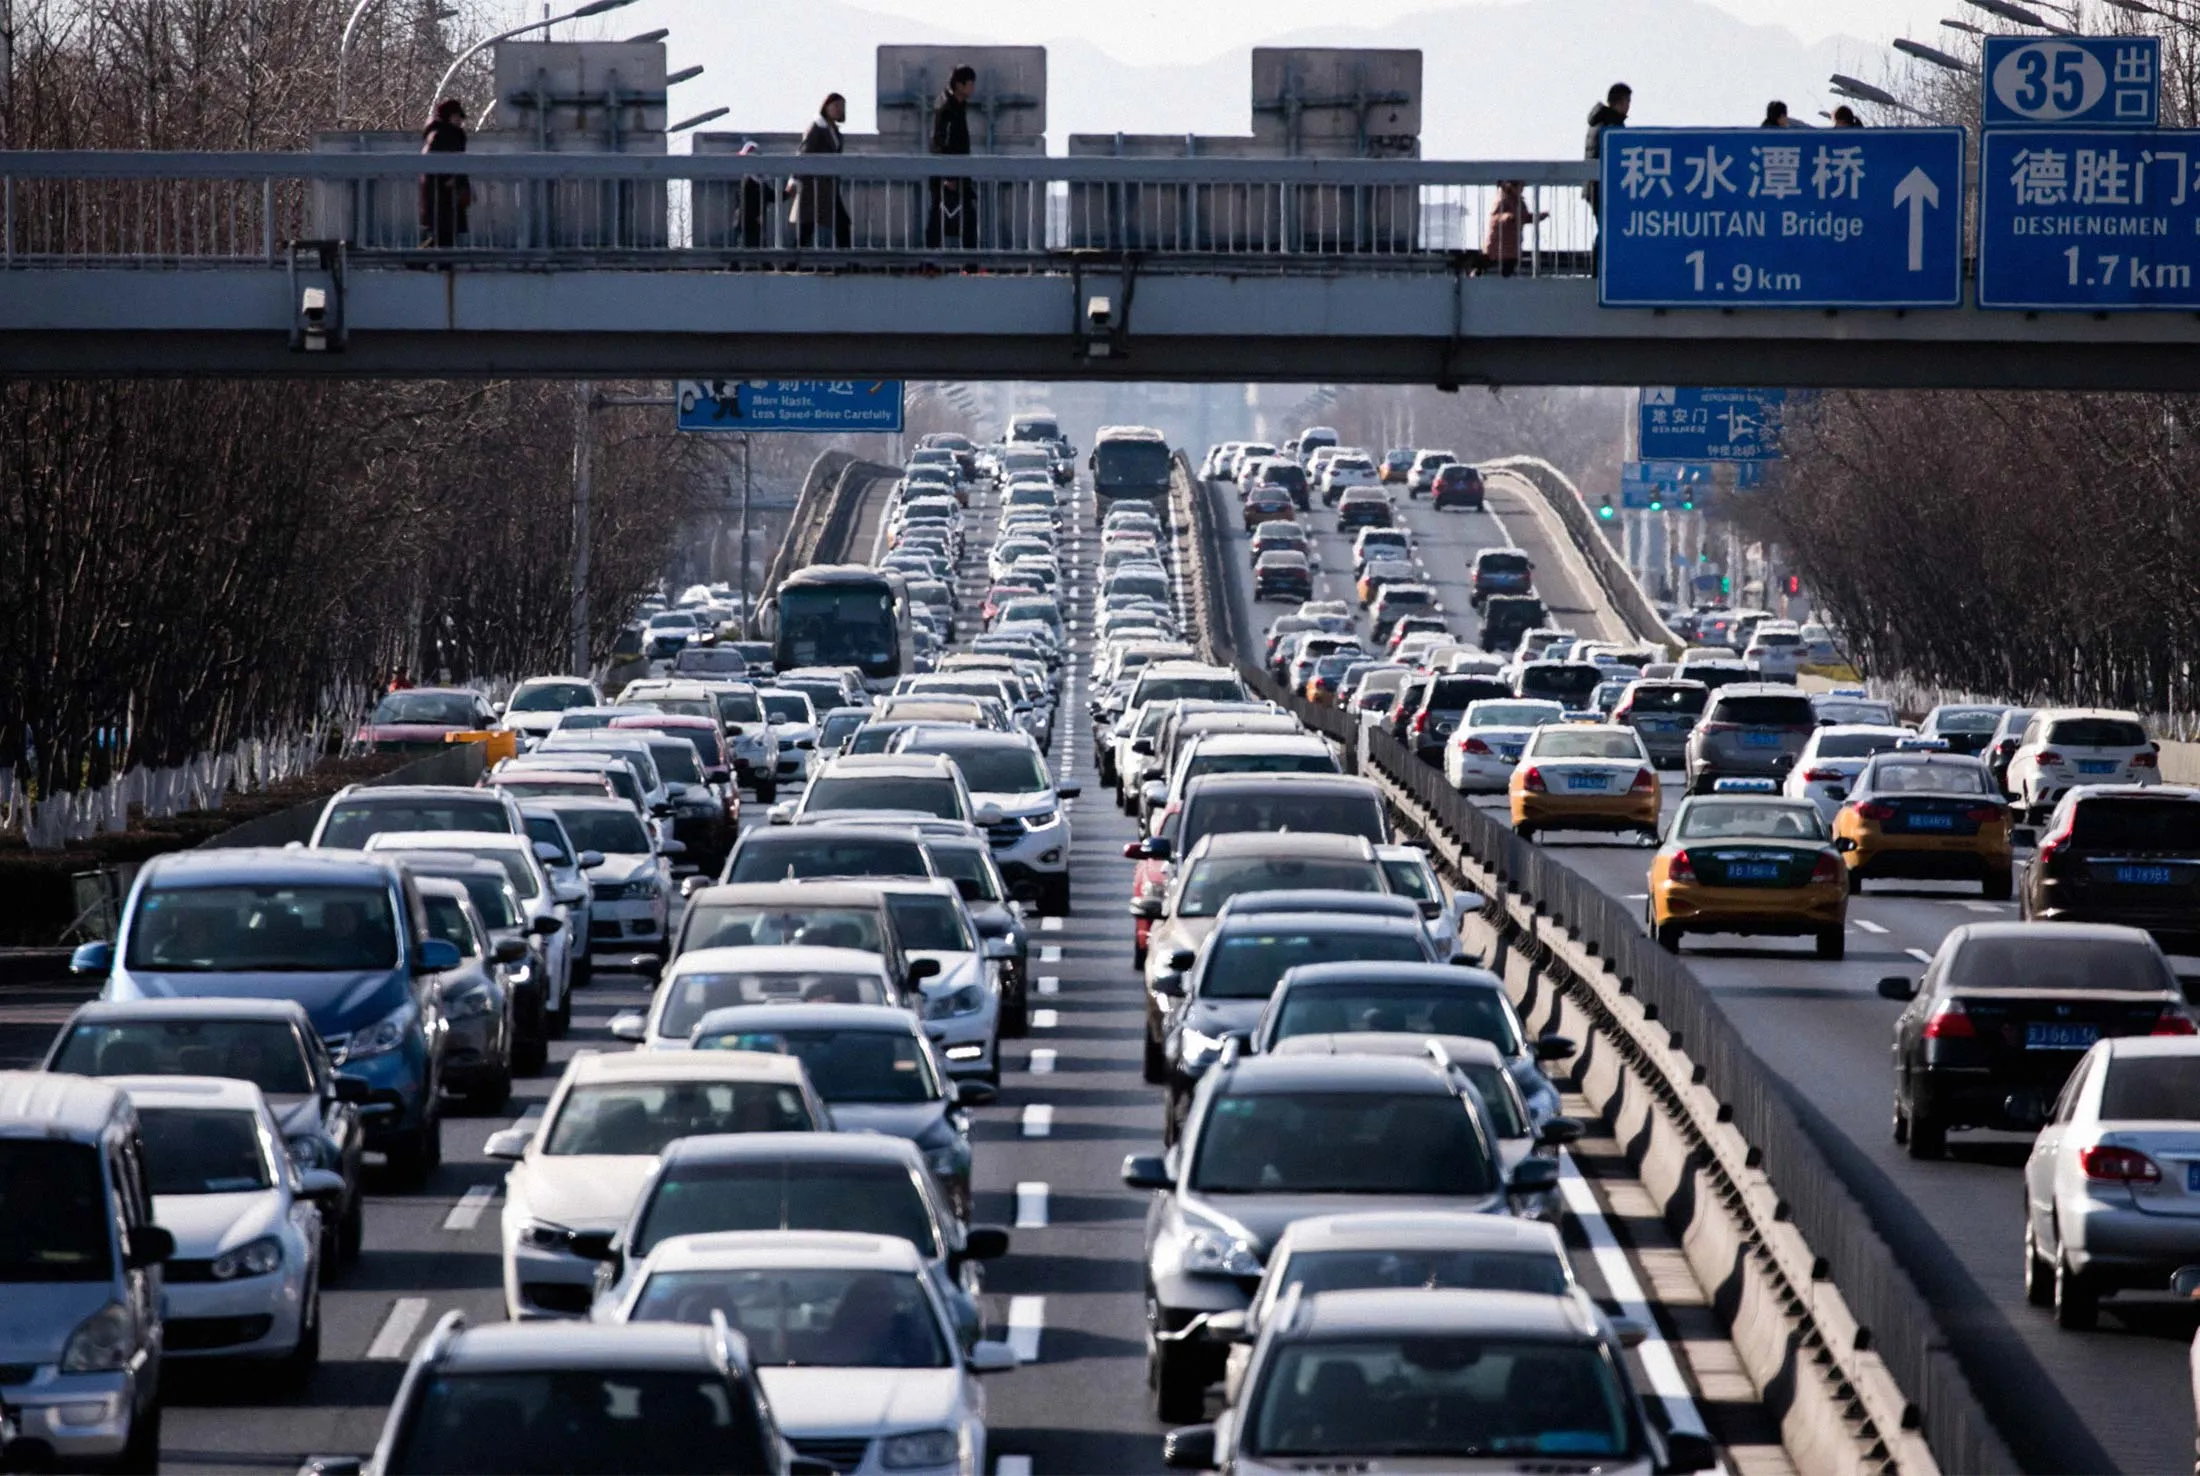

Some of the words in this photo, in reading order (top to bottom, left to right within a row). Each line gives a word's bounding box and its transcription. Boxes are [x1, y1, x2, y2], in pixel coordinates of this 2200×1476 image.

[2015, 49, 2084, 112] 35
[2114, 46, 2151, 117] 出口
[1619, 145, 1866, 200] 积水潭桥
[2010, 148, 2200, 206] 德胜门
[1622, 210, 1766, 238] JISHUITAN
[1781, 210, 1864, 239] Bridge
[2013, 216, 2168, 236] DESHENGMEN
